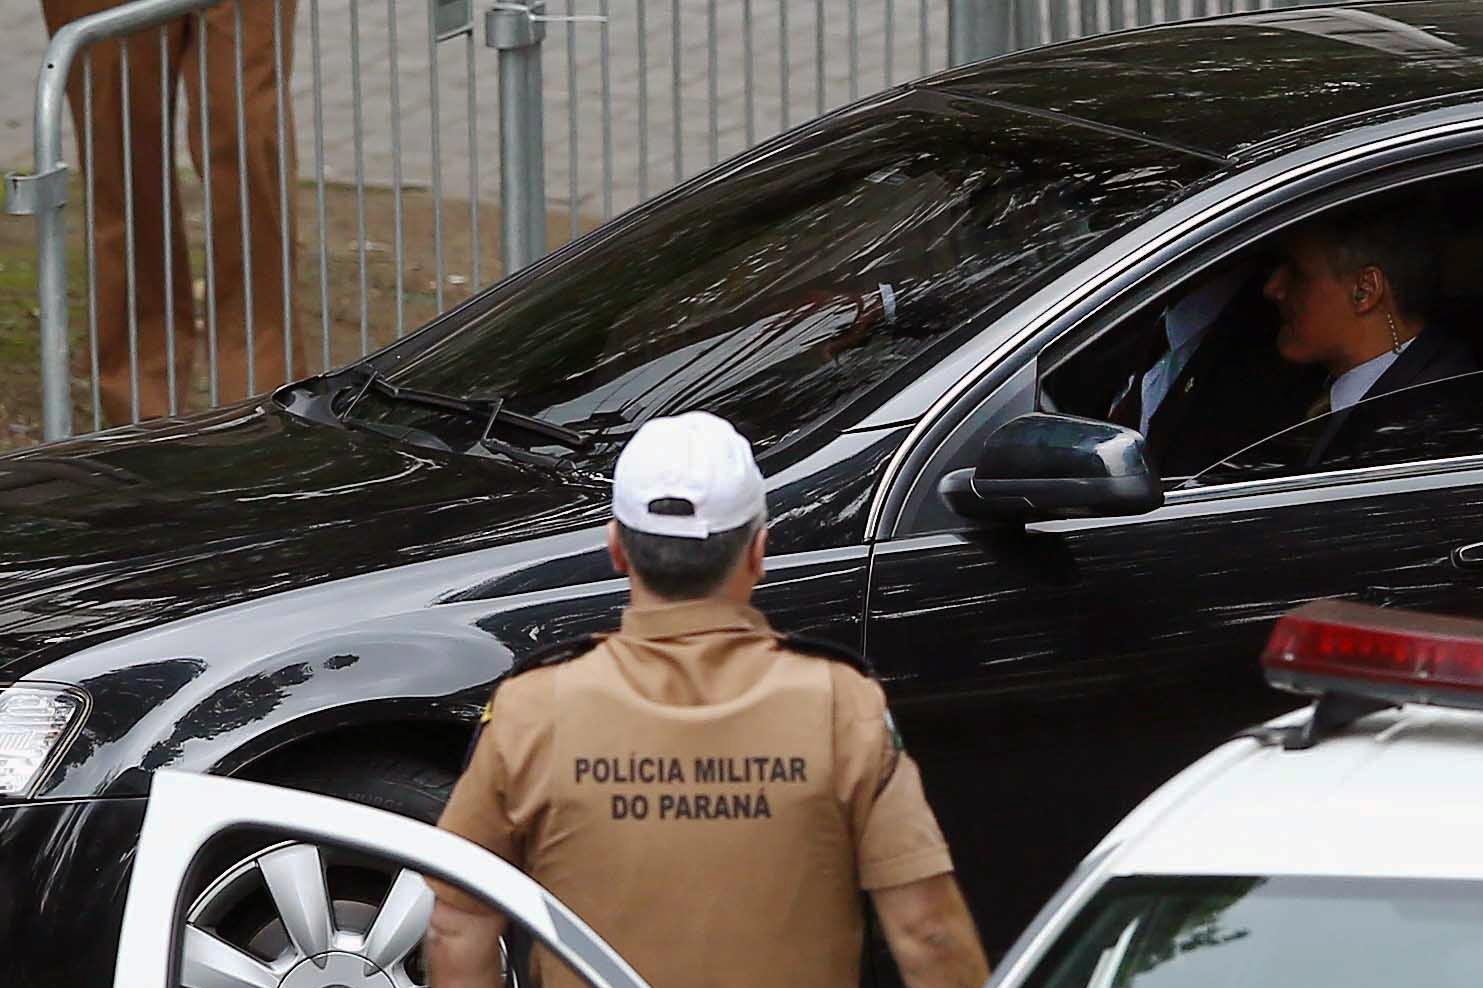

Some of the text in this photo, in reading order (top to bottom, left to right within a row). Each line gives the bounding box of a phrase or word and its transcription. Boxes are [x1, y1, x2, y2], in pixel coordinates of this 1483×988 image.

[575, 751, 807, 783] POLÍCIA MILITAR
[611, 788, 772, 820] DO PARANÁ
